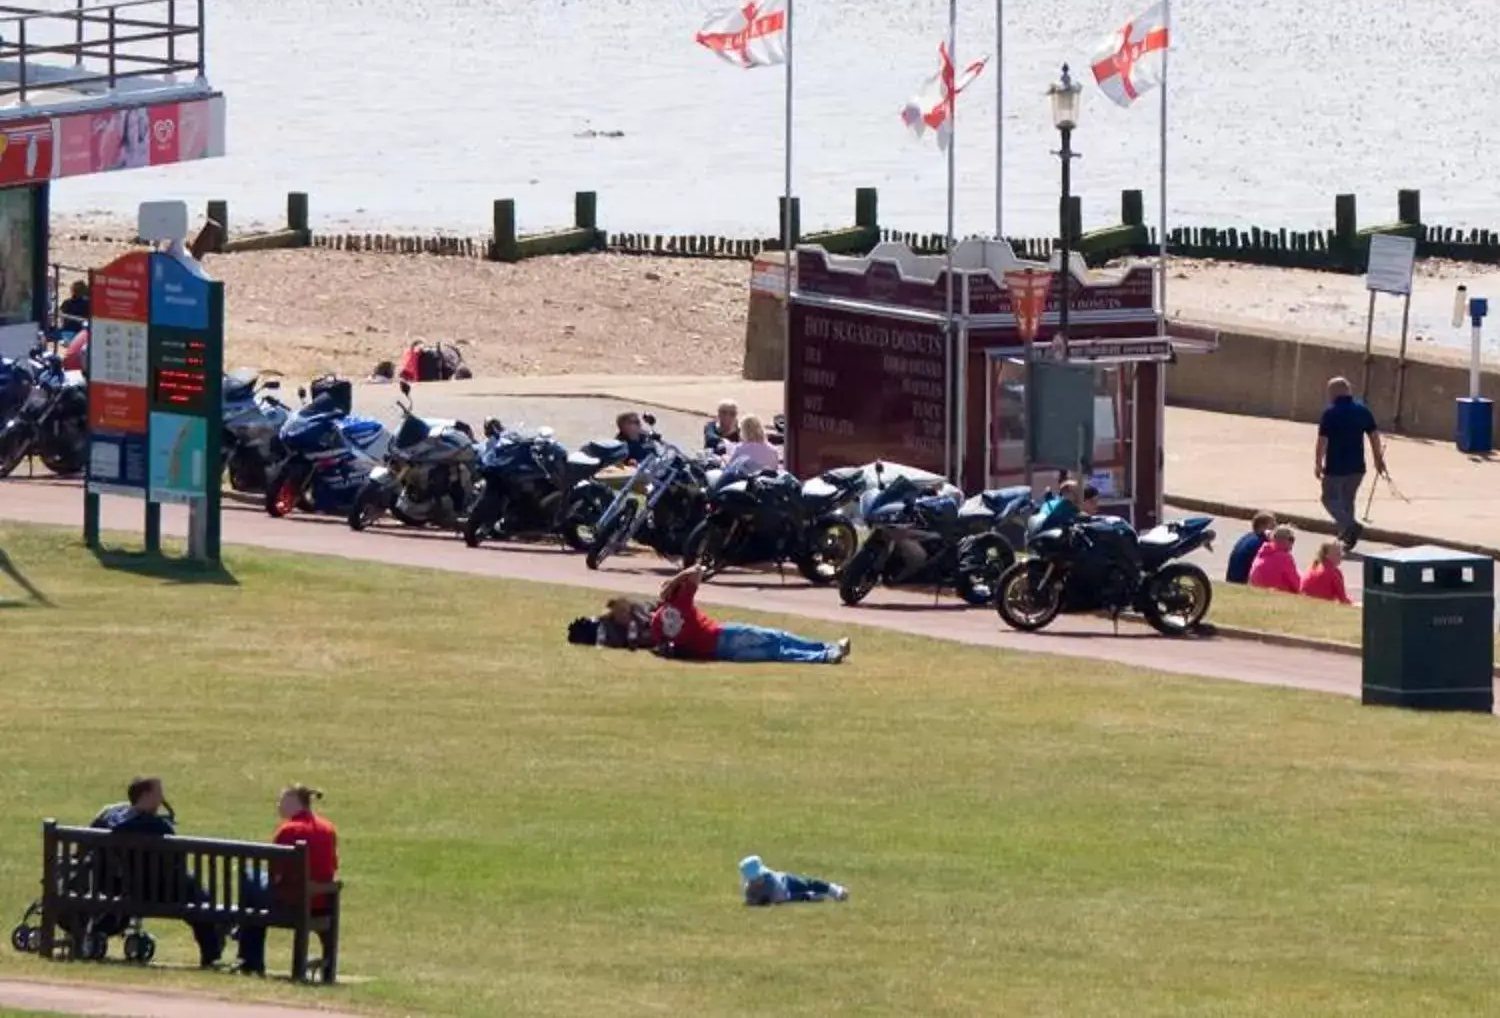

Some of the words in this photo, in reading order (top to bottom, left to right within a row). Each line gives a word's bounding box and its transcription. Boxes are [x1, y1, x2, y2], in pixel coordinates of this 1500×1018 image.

[804, 315, 830, 339] HOT
[832, 320, 889, 346] SUGARED
[891, 329, 942, 354] DONUTS
